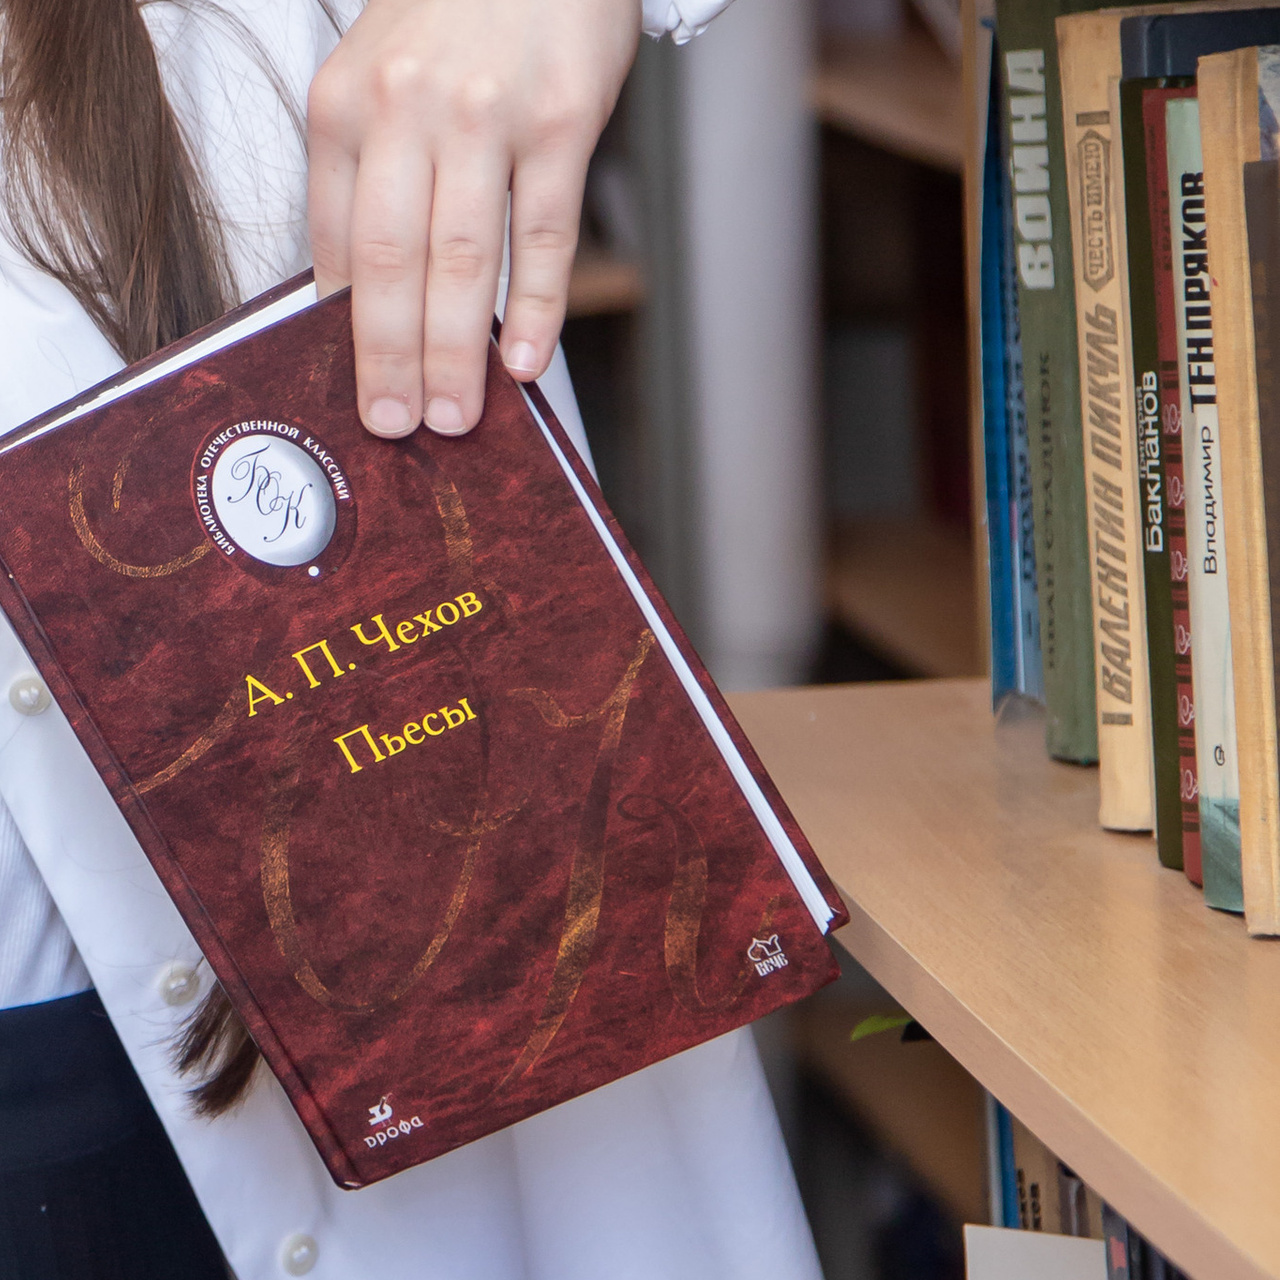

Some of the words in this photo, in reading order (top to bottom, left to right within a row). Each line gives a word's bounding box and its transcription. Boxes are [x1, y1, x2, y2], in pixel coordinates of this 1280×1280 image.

[1005, 48, 1055, 289] ВОЙНА
[1083, 142, 1103, 207] ИМЕЮ
[1086, 210, 1105, 276] ЧЕСТЬ
[1084, 303, 1123, 469] ПИКУЛЬ
[200, 420, 300, 469] ОТЕЧЕСТВЕННОЙ
[302, 437, 350, 500] КЛАССИКИ
[1142, 371, 1163, 552] Бакланов
[196, 475, 236, 556] БИБЛИОТЕКА
[1201, 426, 1218, 575] Владимир
[1092, 472, 1133, 704] ВАЛЕНТИН
[245, 674, 293, 717] А.
[292, 639, 356, 689] П.
[350, 591, 483, 652] Чехов
[333, 697, 477, 773] Пьесы
